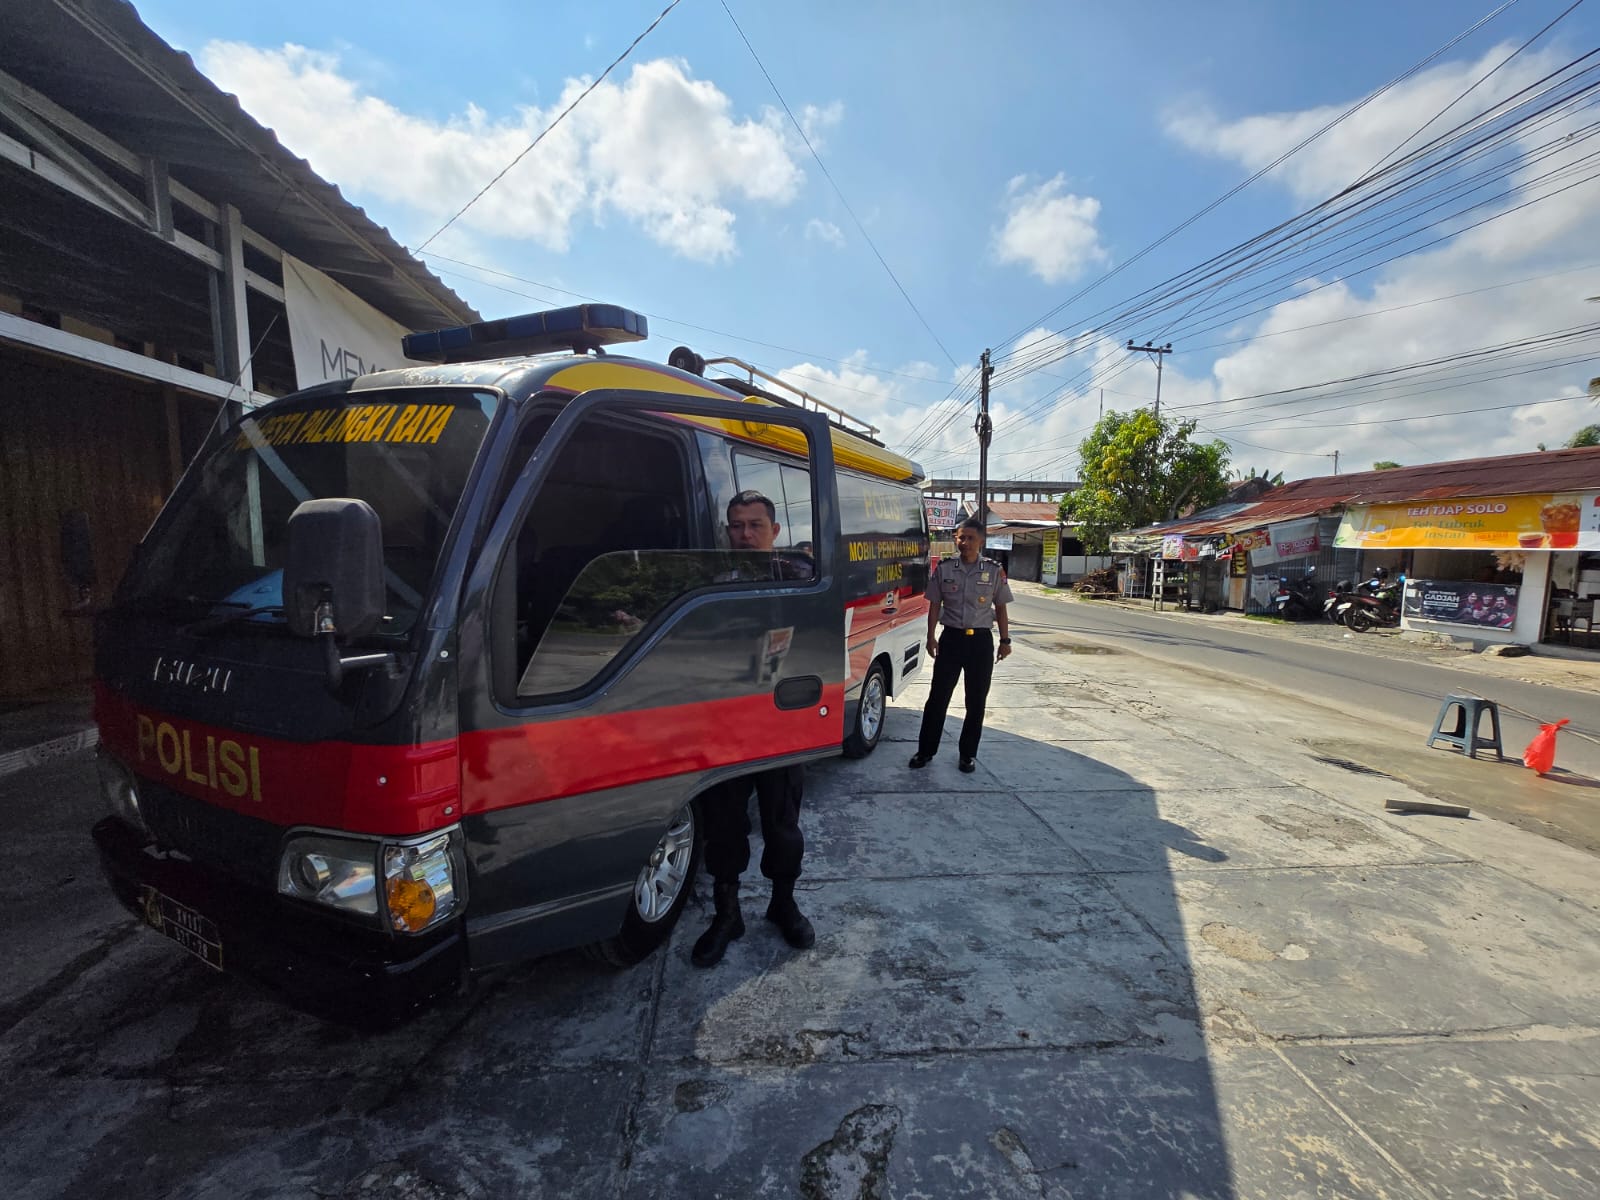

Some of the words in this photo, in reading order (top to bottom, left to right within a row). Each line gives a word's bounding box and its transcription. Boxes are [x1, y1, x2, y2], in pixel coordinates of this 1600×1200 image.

[291, 405, 398, 443] PALANGKA
[385, 404, 455, 443] RAYA
[1433, 505, 1464, 515] TJAP
[1467, 503, 1507, 514] SOLO
[849, 541, 876, 561] MOBIL
[1424, 594, 1460, 602] GADJAH
[137, 714, 262, 801] POLISI
